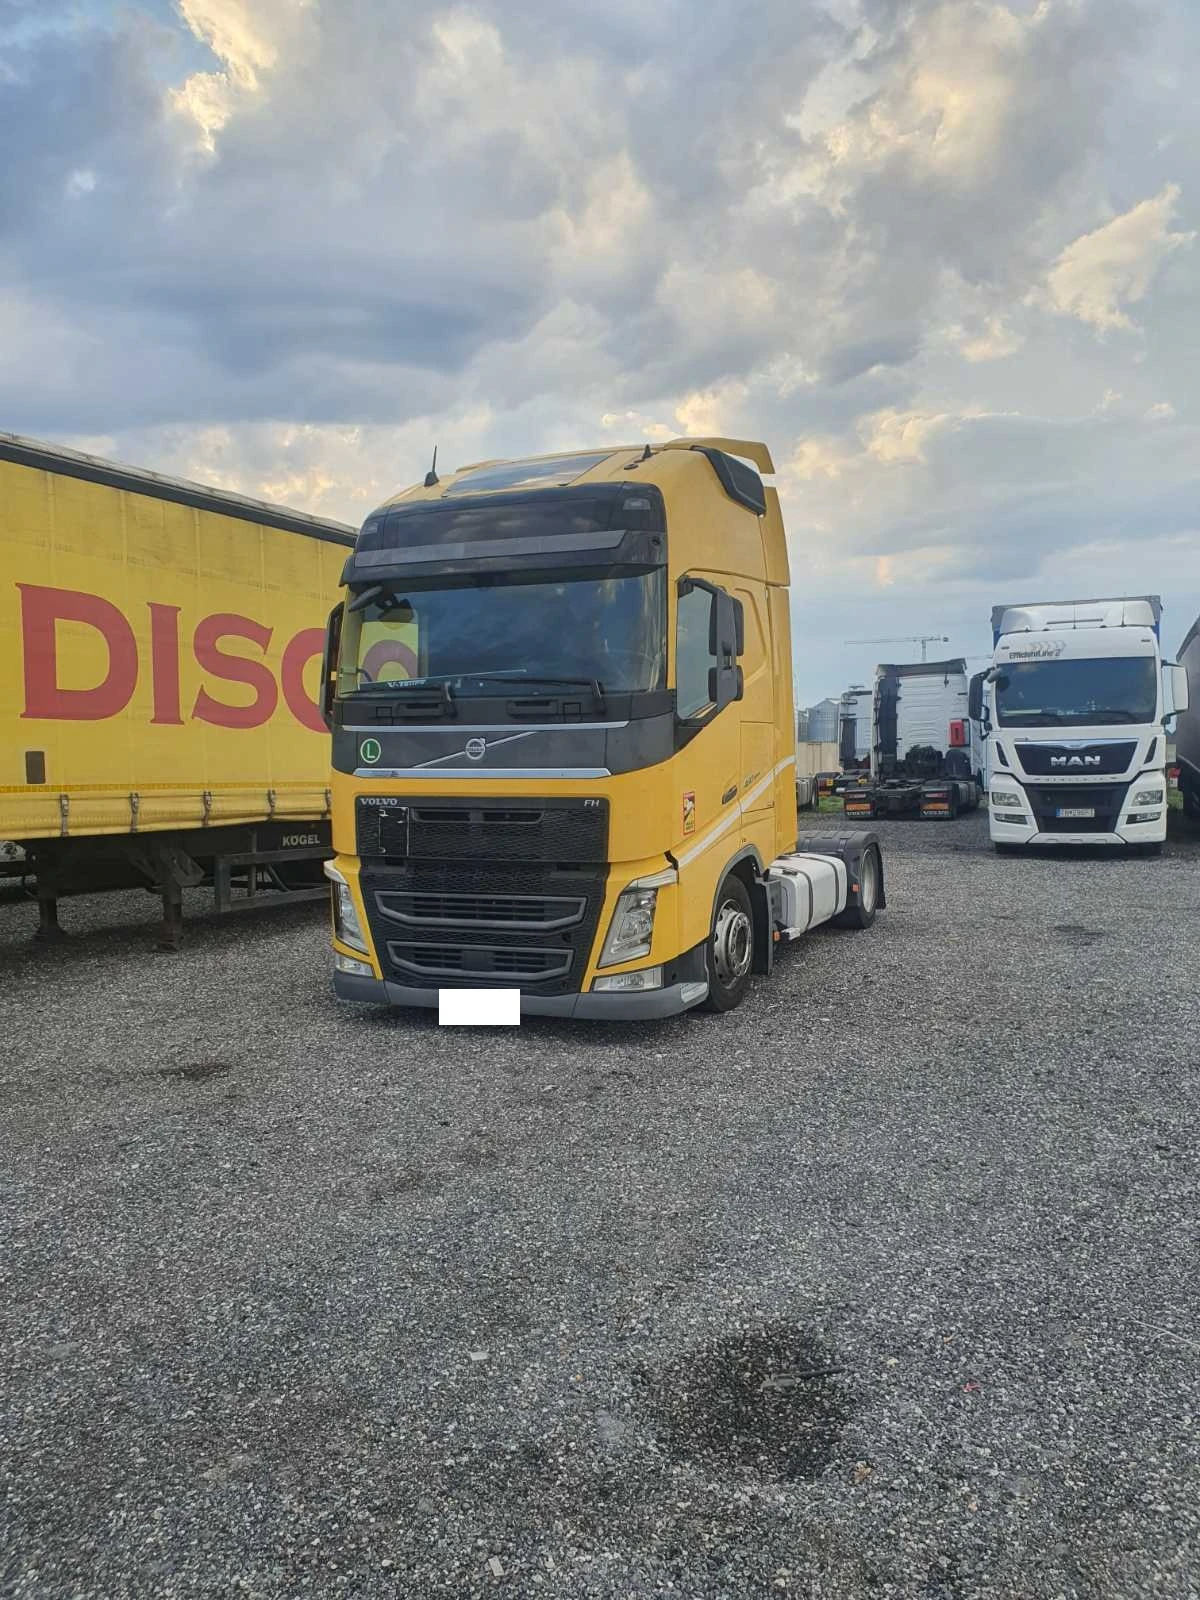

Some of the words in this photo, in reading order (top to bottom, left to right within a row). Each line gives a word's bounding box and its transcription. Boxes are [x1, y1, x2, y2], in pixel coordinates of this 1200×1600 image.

[1050, 755, 1101, 767] MAN
[360, 797, 398, 806] VOLVO
[584, 799, 600, 807] FH
